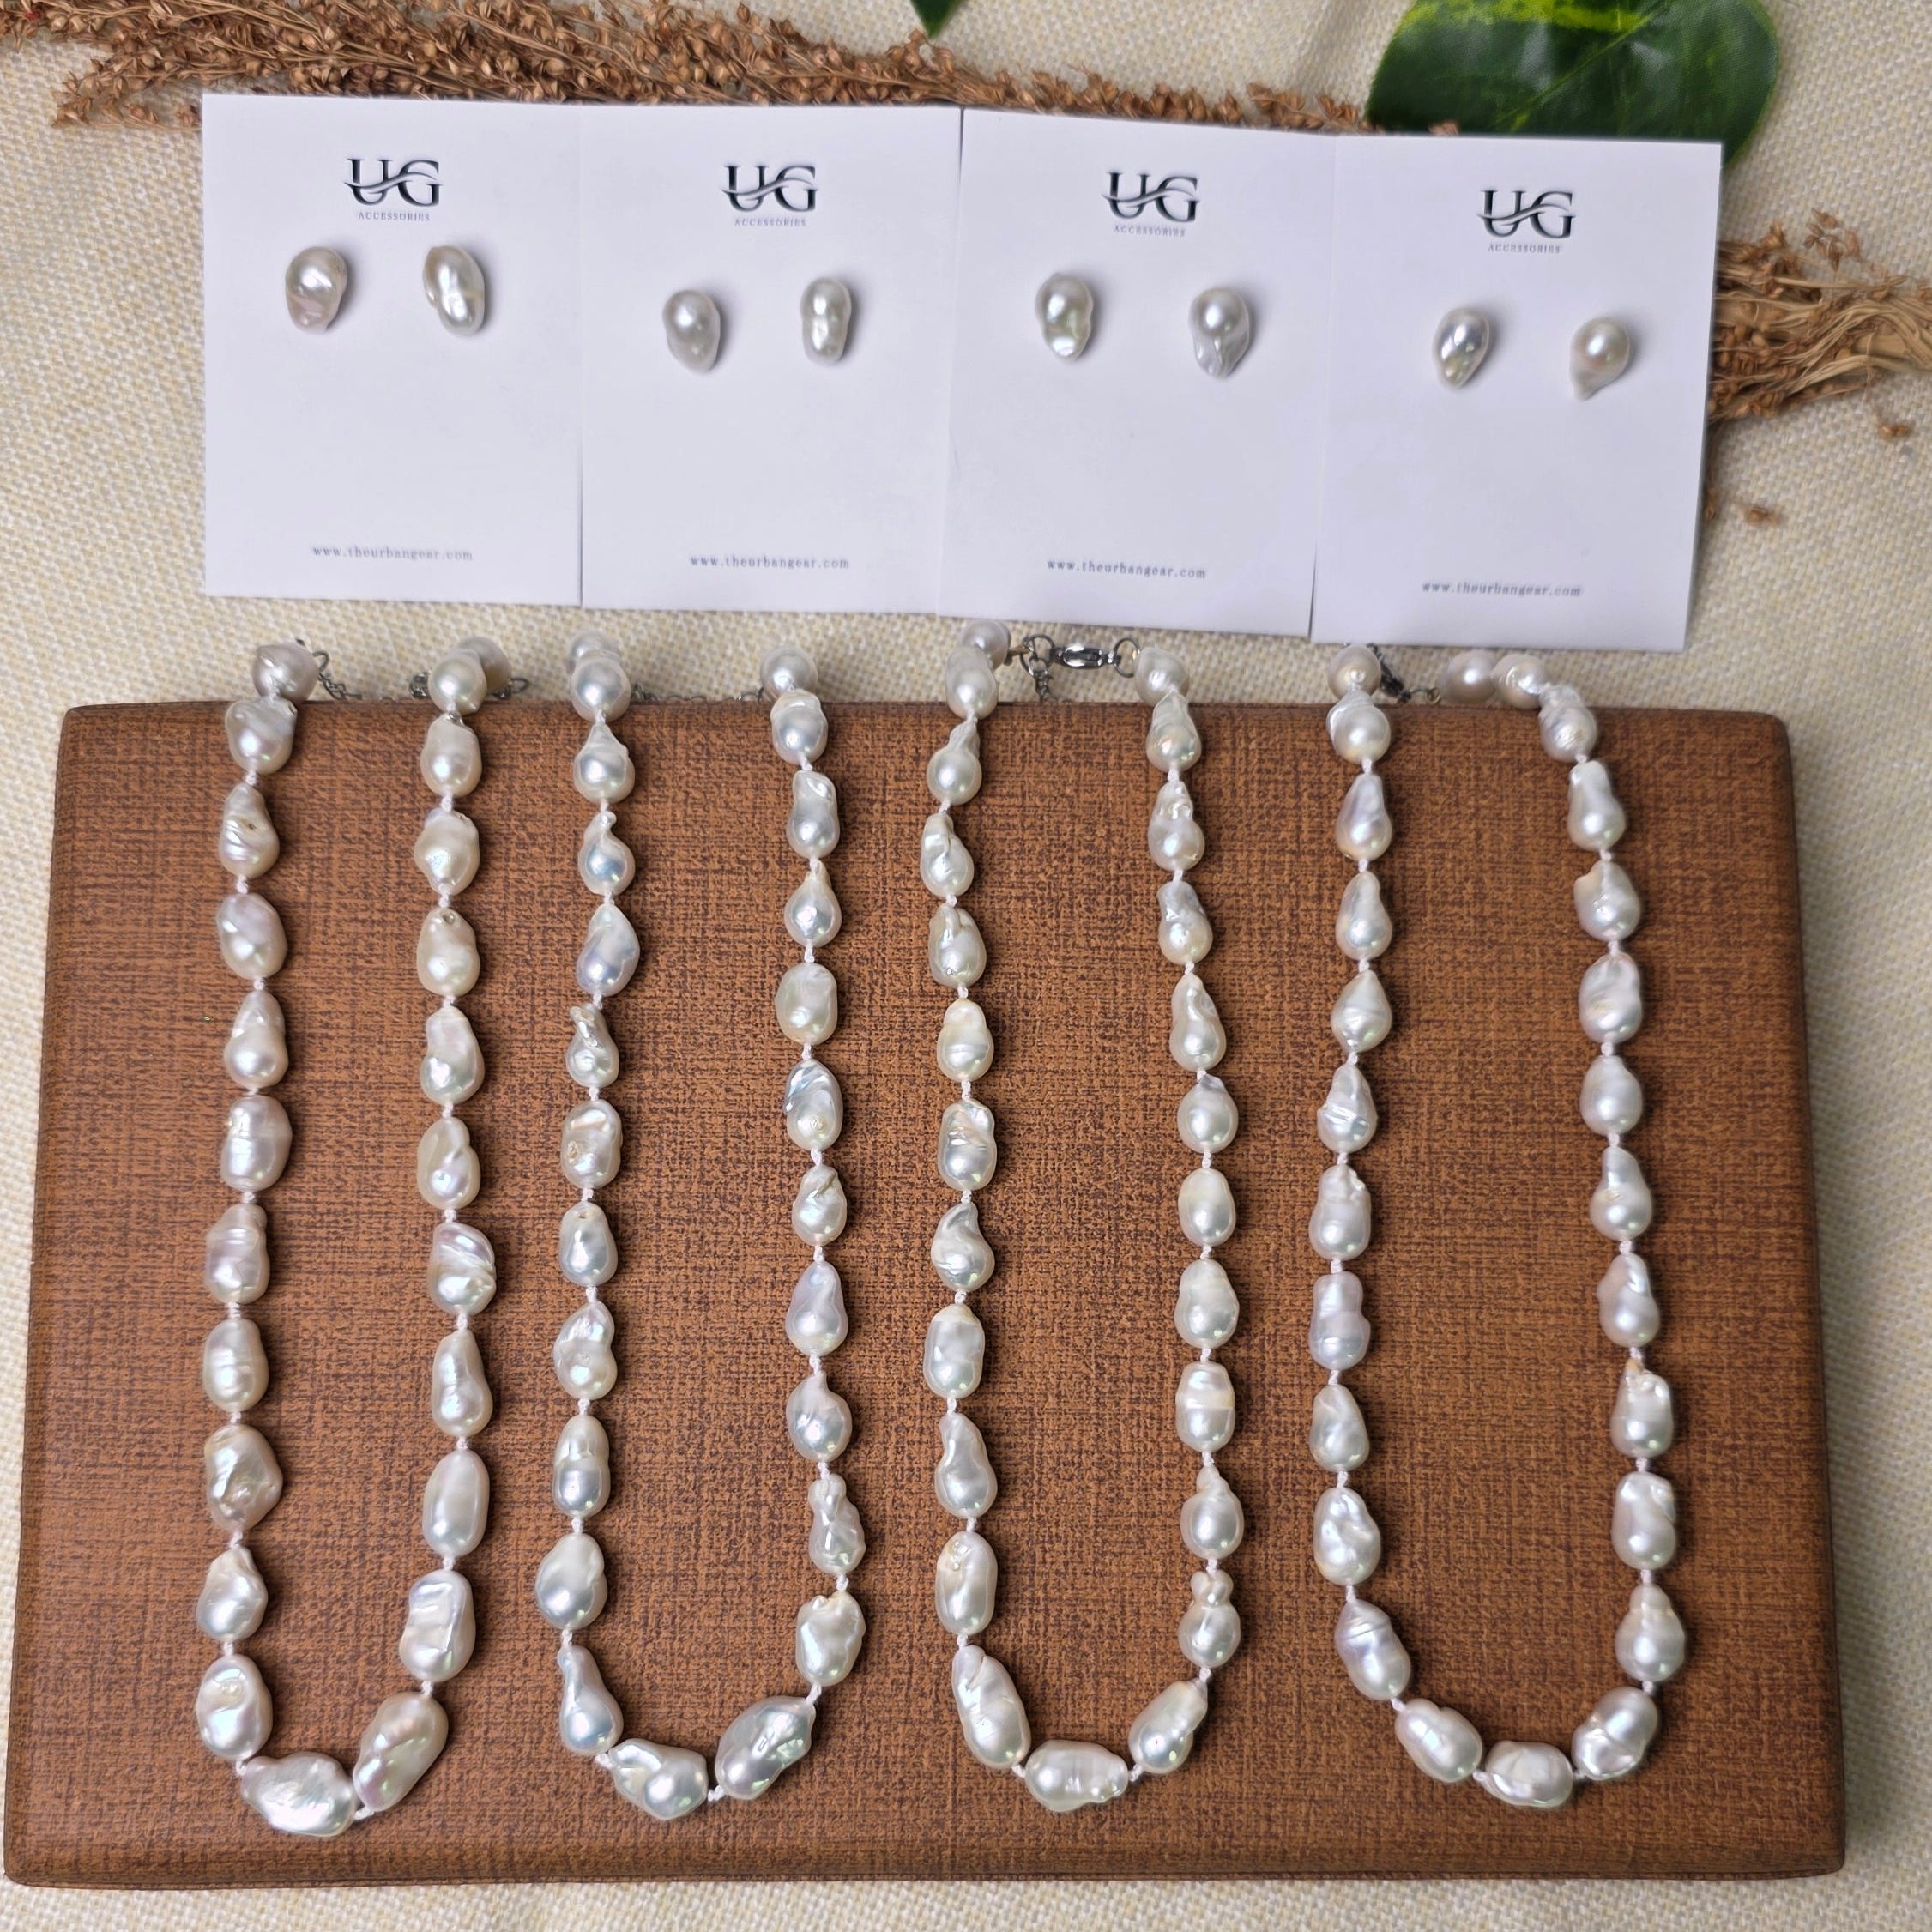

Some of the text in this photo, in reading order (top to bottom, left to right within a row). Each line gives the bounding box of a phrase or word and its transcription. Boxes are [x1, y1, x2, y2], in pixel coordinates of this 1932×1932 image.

[358, 211, 432, 222] ACCESSORIES
[734, 217, 806, 227] ACCESSORIES
[1113, 225, 1186, 237] ACCESSORIES
[1488, 243, 1562, 254] ACCESSORIES
[311, 545, 473, 561] www.theurbangear.com
[690, 554, 849, 570] www.theurbangear.com
[1047, 560, 1206, 578] www.theurbangear.com
[1422, 581, 1581, 598] www.theurbangear.com
